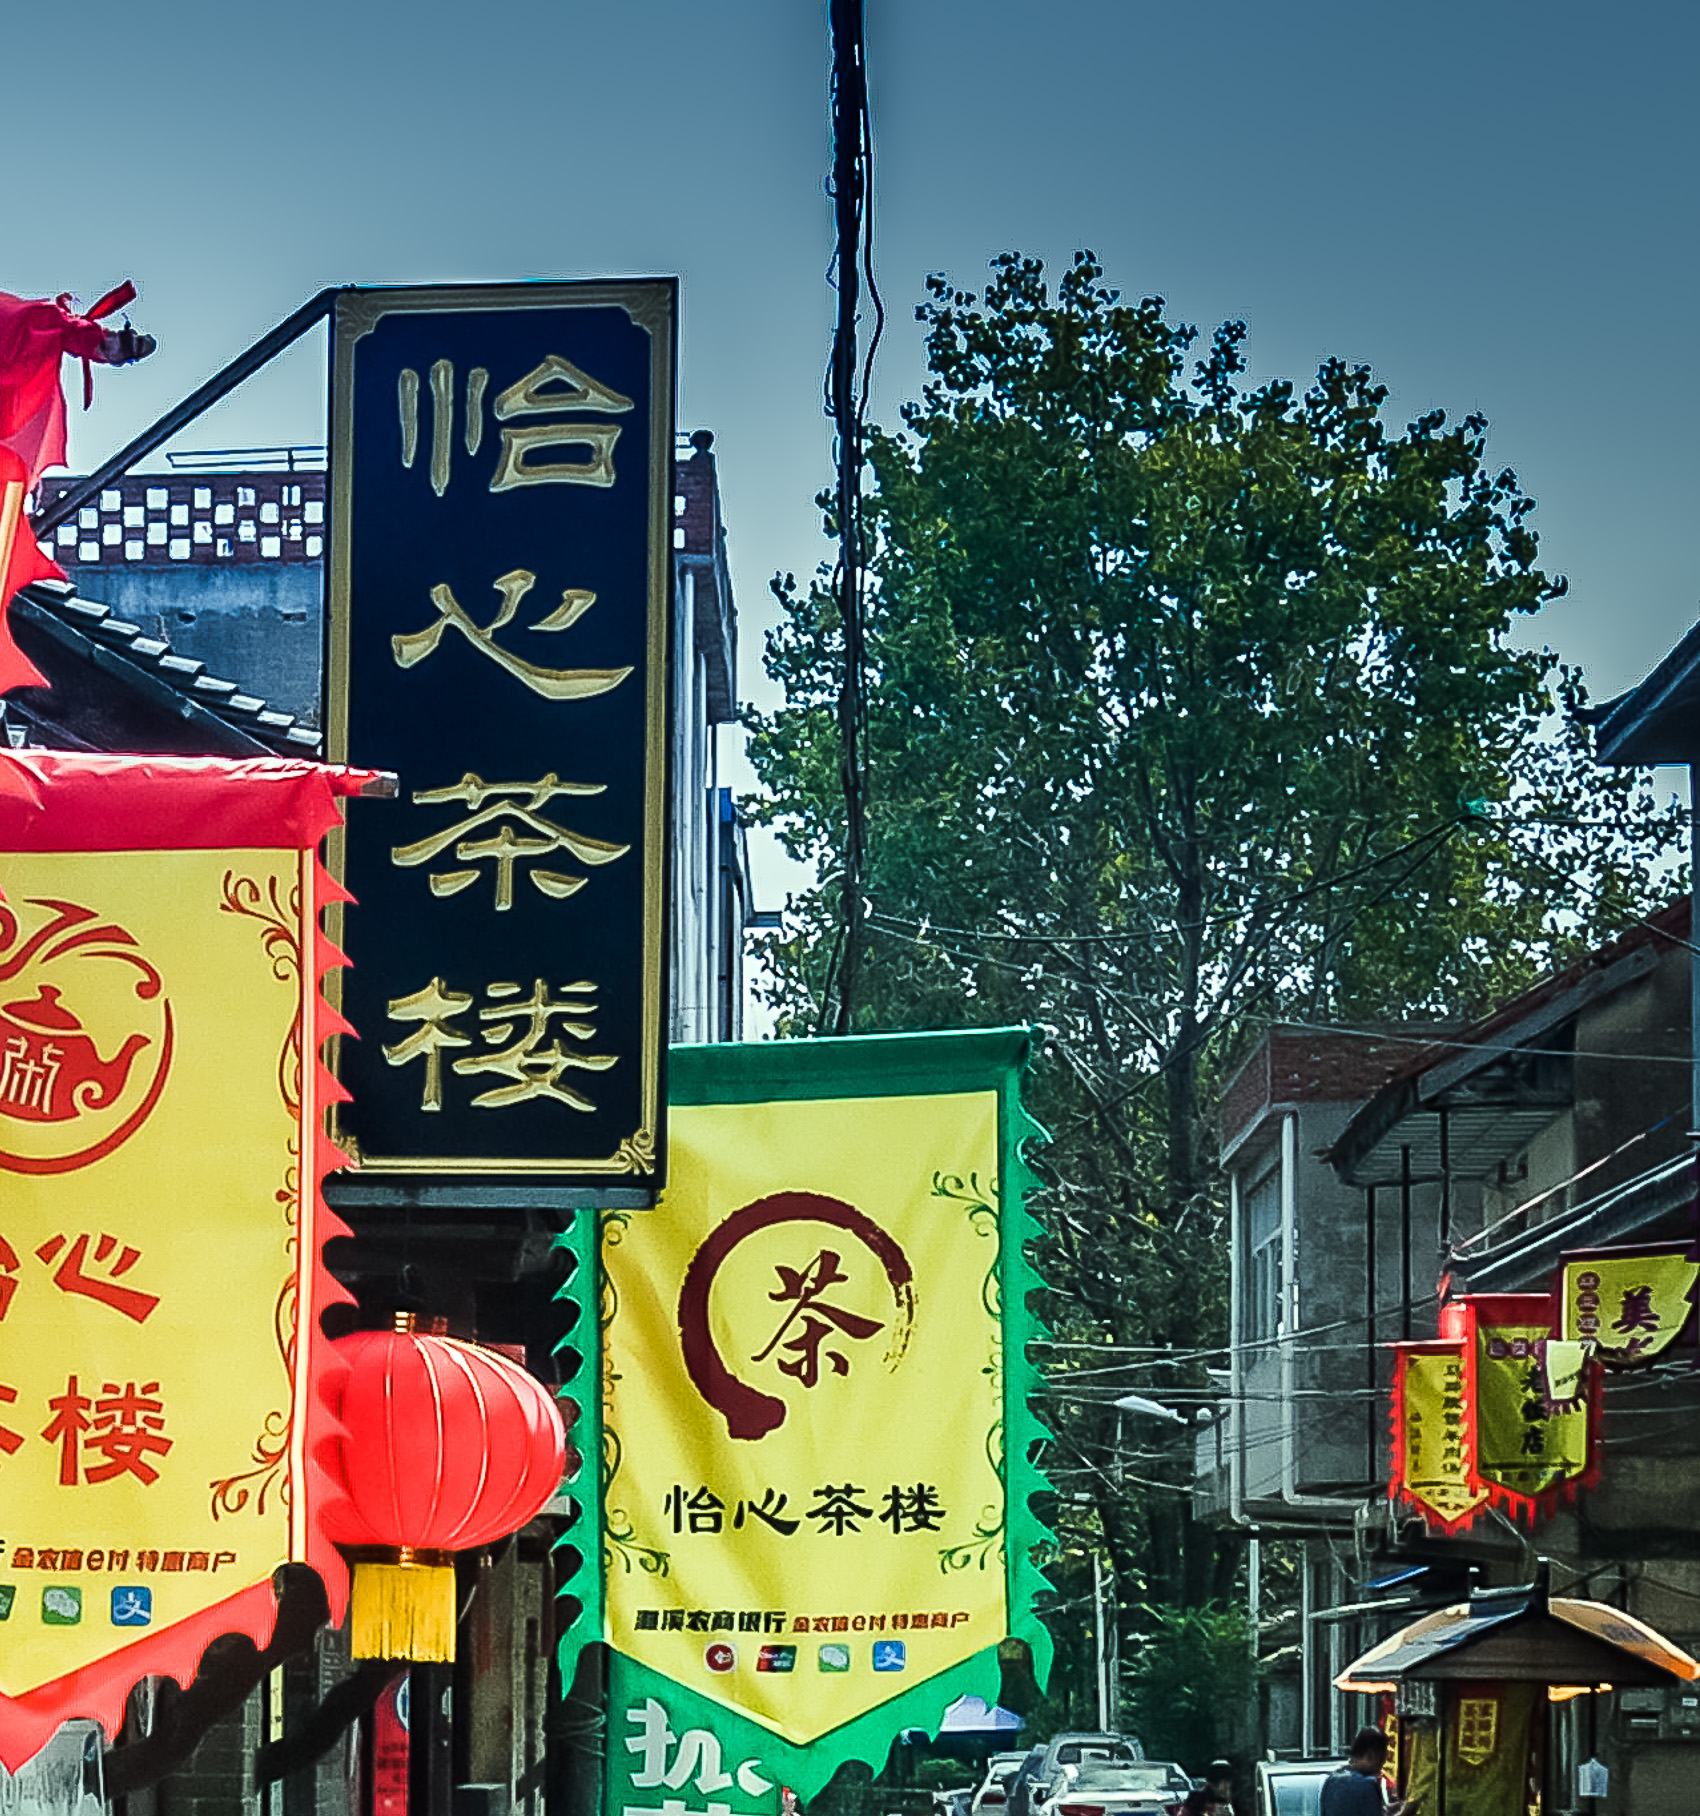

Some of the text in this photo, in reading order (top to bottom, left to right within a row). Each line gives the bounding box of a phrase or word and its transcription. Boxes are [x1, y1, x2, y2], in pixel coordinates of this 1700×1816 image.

[381, 354, 635, 1112] 怡心茶楼
[751, 1249, 885, 1388] 茶
[664, 1482, 947, 1537] 怡心茶楼
